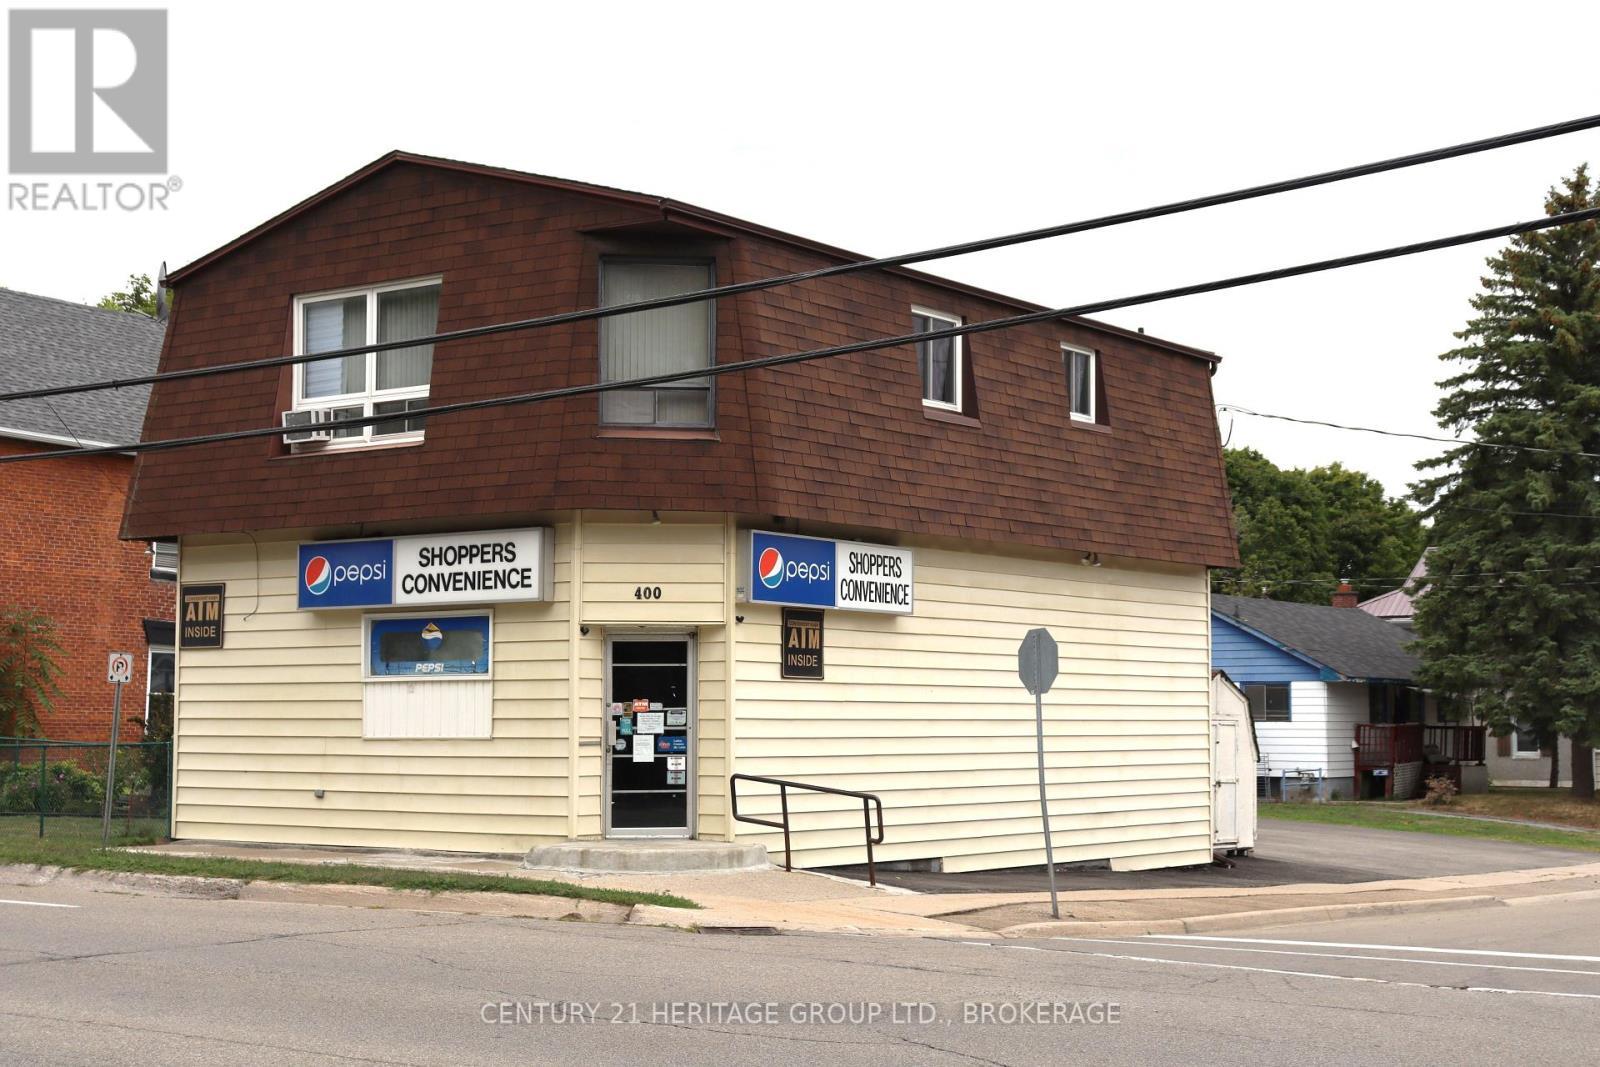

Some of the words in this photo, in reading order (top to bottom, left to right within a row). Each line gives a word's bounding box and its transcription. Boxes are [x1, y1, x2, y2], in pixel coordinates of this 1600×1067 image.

[418, 542, 517, 568] SHOPPERS
[848, 551, 902, 579] SHOPPERS
[333, 559, 386, 587] pepsi
[401, 568, 532, 594] CONVENIENCE
[786, 561, 830, 584] pepsi
[634, 586, 662, 600] 400
[840, 578, 910, 606] CONVENIENCE
[185, 595, 219, 621] ATM
[184, 626, 216, 638] INSIDE
[788, 620, 820, 649] ATM
[414, 662, 445, 673] PEPSI
[787, 654, 818, 667] INSIDE
